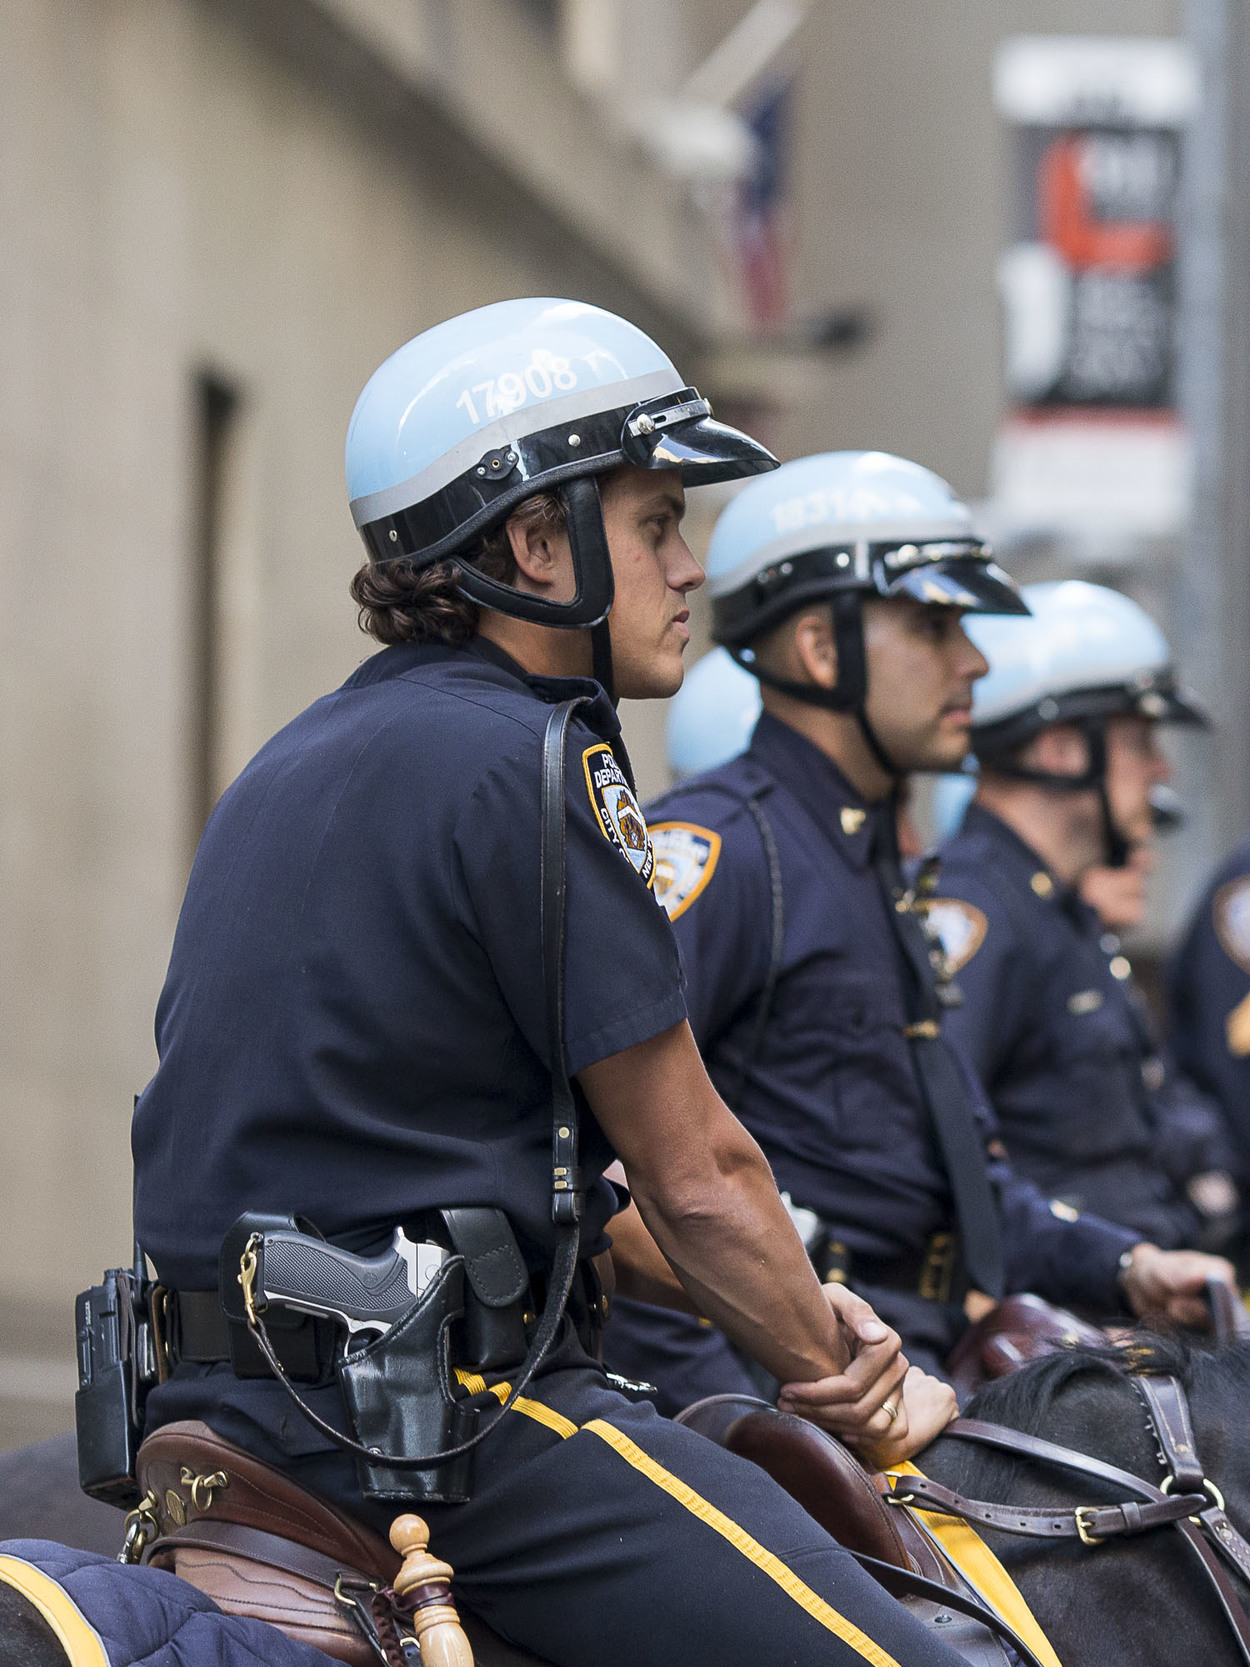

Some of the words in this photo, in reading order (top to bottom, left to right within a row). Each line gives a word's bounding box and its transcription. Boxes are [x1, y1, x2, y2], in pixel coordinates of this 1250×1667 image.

[456, 356, 578, 424] 17908
[600, 808, 620, 843] CITY
[642, 849, 653, 879] NEW
